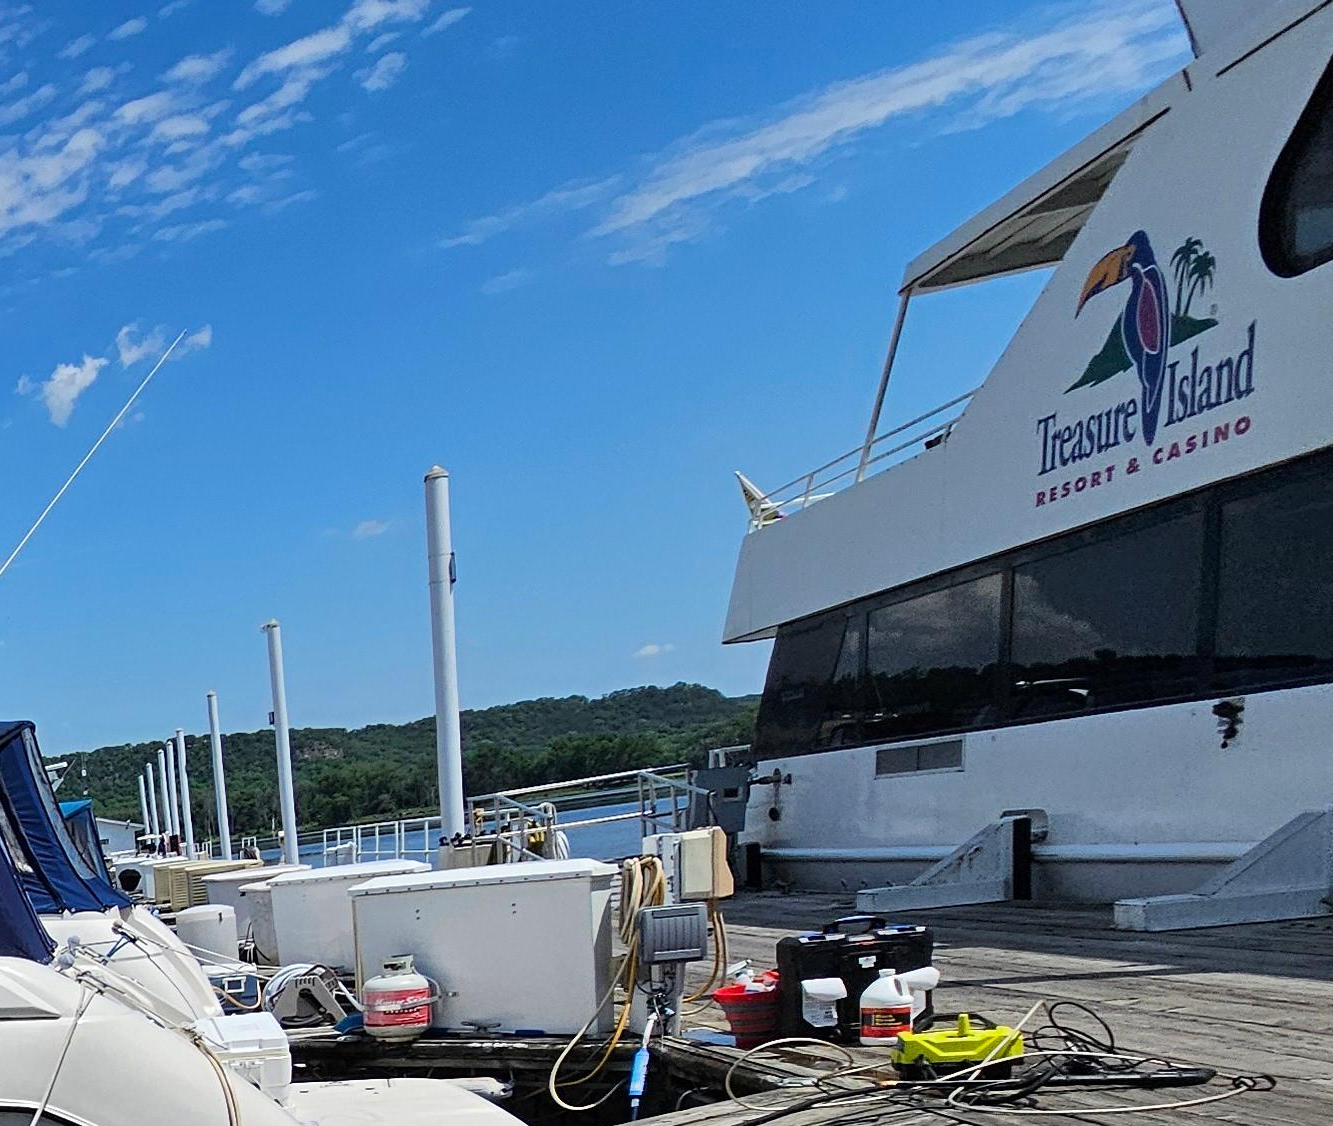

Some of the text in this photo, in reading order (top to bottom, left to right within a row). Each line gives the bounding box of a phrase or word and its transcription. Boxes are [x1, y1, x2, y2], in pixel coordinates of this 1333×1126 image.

[1036, 318, 1258, 476] Treasure Island
[1035, 415, 1252, 508] RESORT & CASINO
